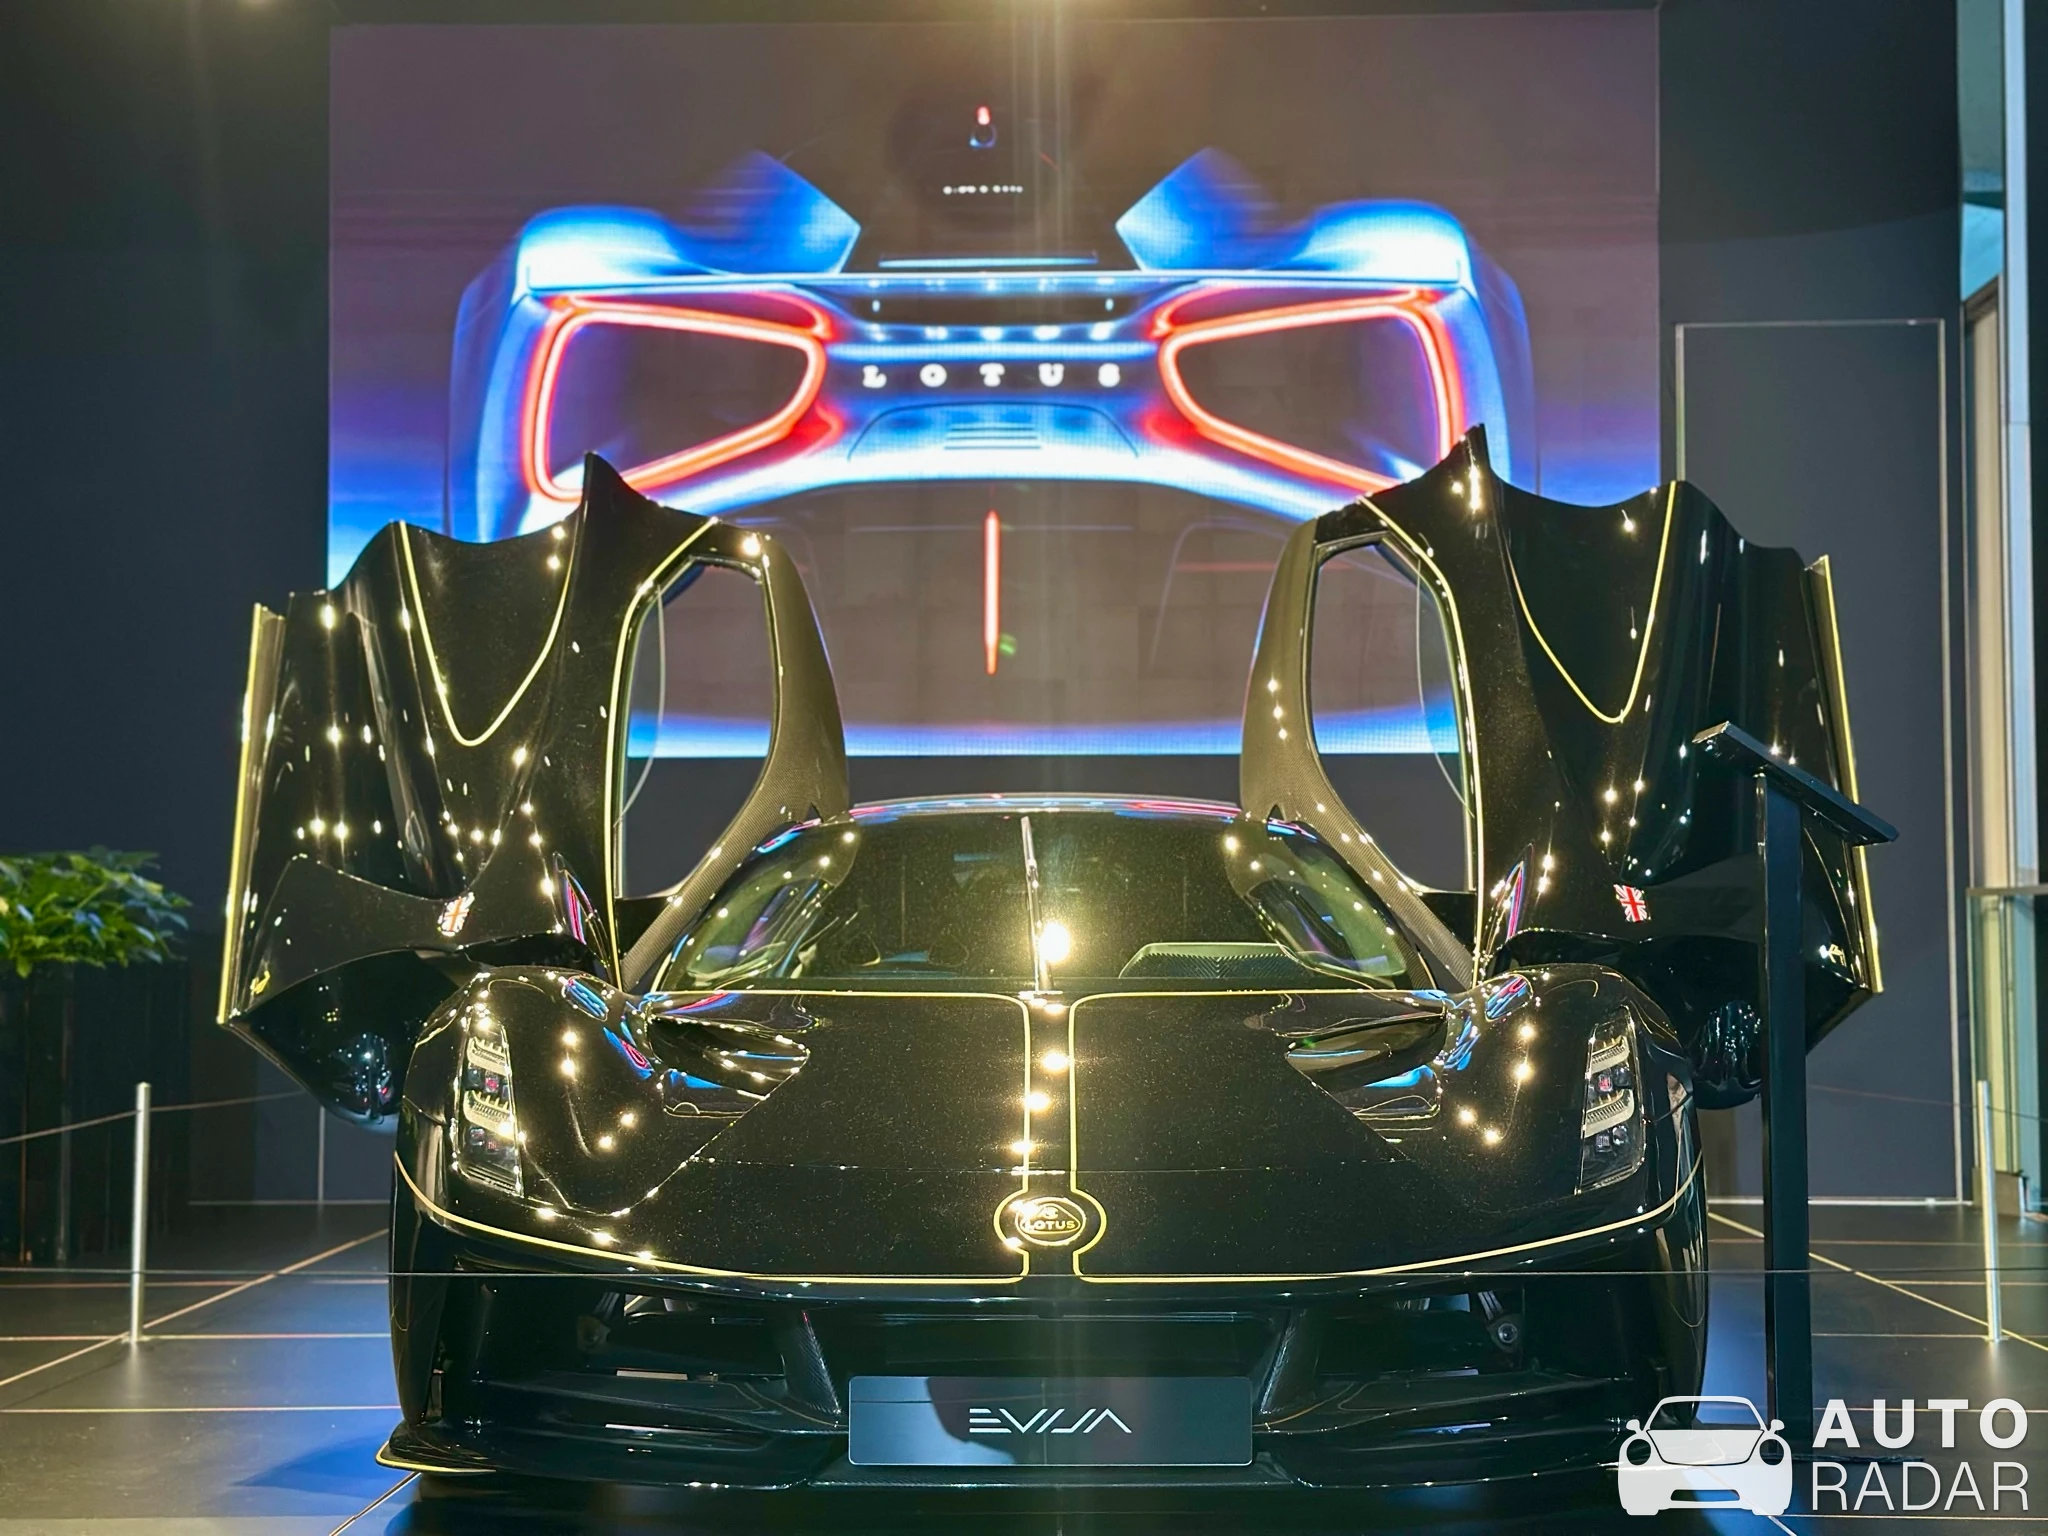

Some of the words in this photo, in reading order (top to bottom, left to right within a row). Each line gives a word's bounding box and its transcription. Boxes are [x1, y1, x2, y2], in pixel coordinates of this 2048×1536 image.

[863, 363, 1120, 388] LOTUS
[1024, 1220, 1076, 1230] LOTUS
[969, 1408, 1132, 1434] EVIJA
